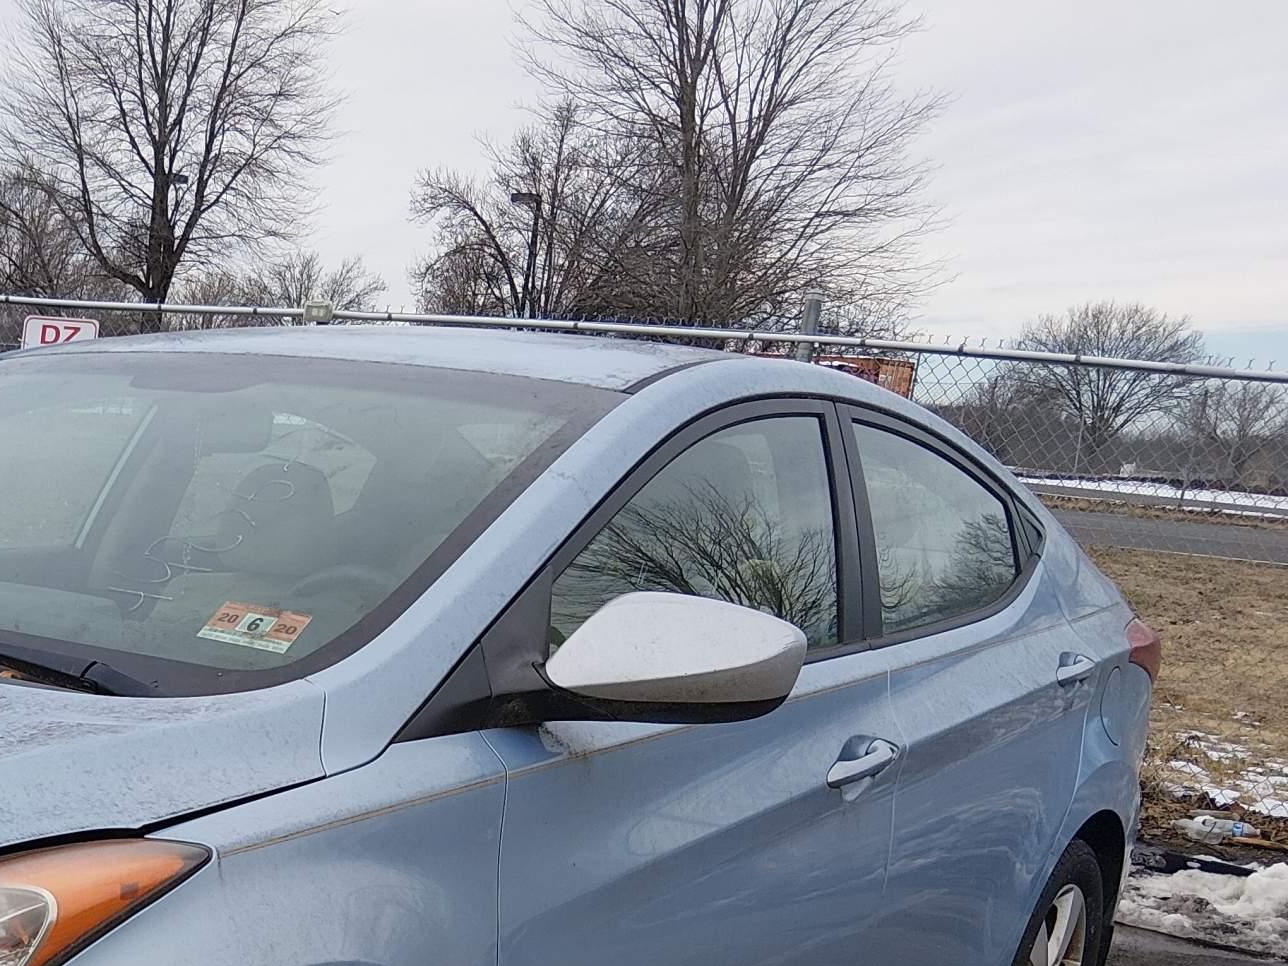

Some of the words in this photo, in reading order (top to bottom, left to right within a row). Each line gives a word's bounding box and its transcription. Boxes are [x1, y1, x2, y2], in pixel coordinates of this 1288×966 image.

[40, 324, 81, 345] DZ
[217, 613, 239, 624] 20
[247, 617, 264, 632] 6
[274, 623, 297, 635] 20
